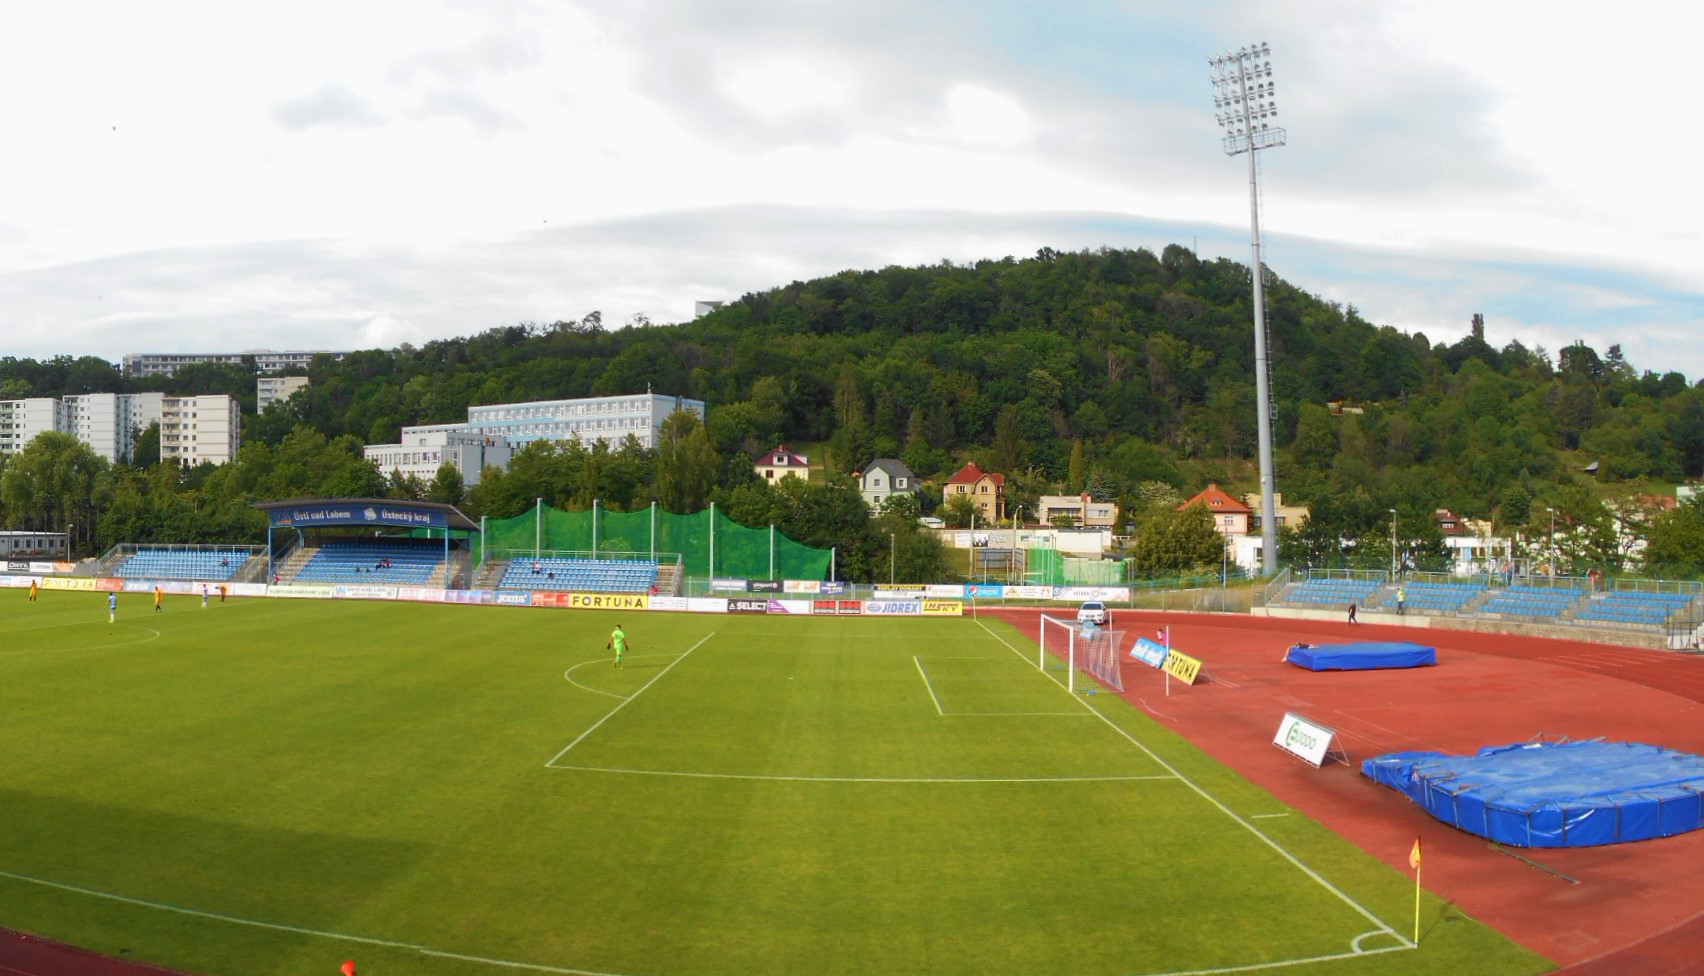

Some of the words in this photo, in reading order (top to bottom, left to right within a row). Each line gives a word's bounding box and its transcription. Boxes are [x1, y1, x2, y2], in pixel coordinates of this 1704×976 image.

[294, 510, 310, 521] Ústí
[311, 511, 324, 519] nad
[326, 510, 351, 519] Labem
[382, 509, 412, 522] Ústecký
[414, 512, 430, 524] kraj
[977, 587, 999, 597] pepsi
[572, 596, 643, 608] FORTUNA
[736, 602, 766, 611] SELECT
[882, 602, 919, 613] JIDREX
